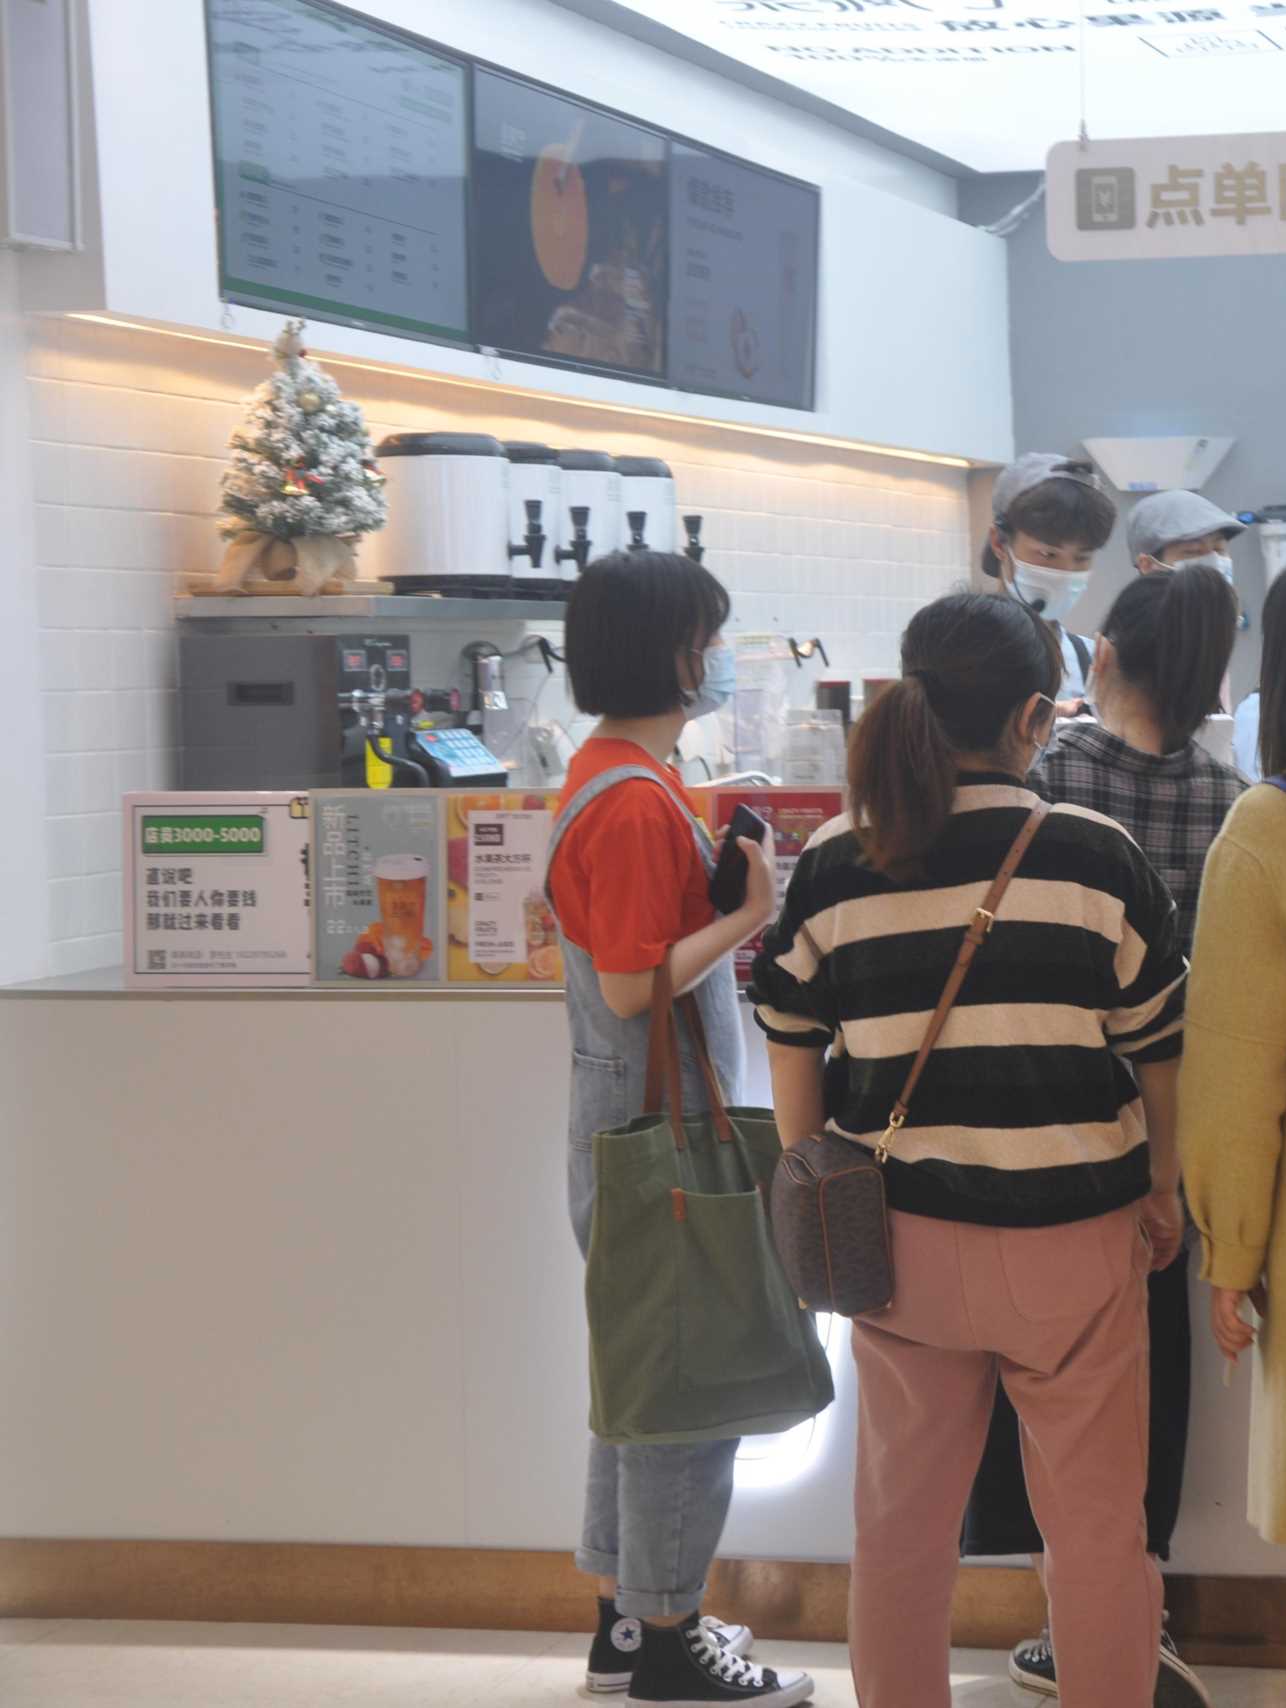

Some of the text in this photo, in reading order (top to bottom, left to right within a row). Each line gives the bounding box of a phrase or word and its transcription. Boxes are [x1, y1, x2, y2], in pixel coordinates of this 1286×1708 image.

[323, 805, 346, 908] 新品上市
[147, 890, 257, 908] 我们要人你要钱
[147, 912, 240, 931] 那就过来看看
